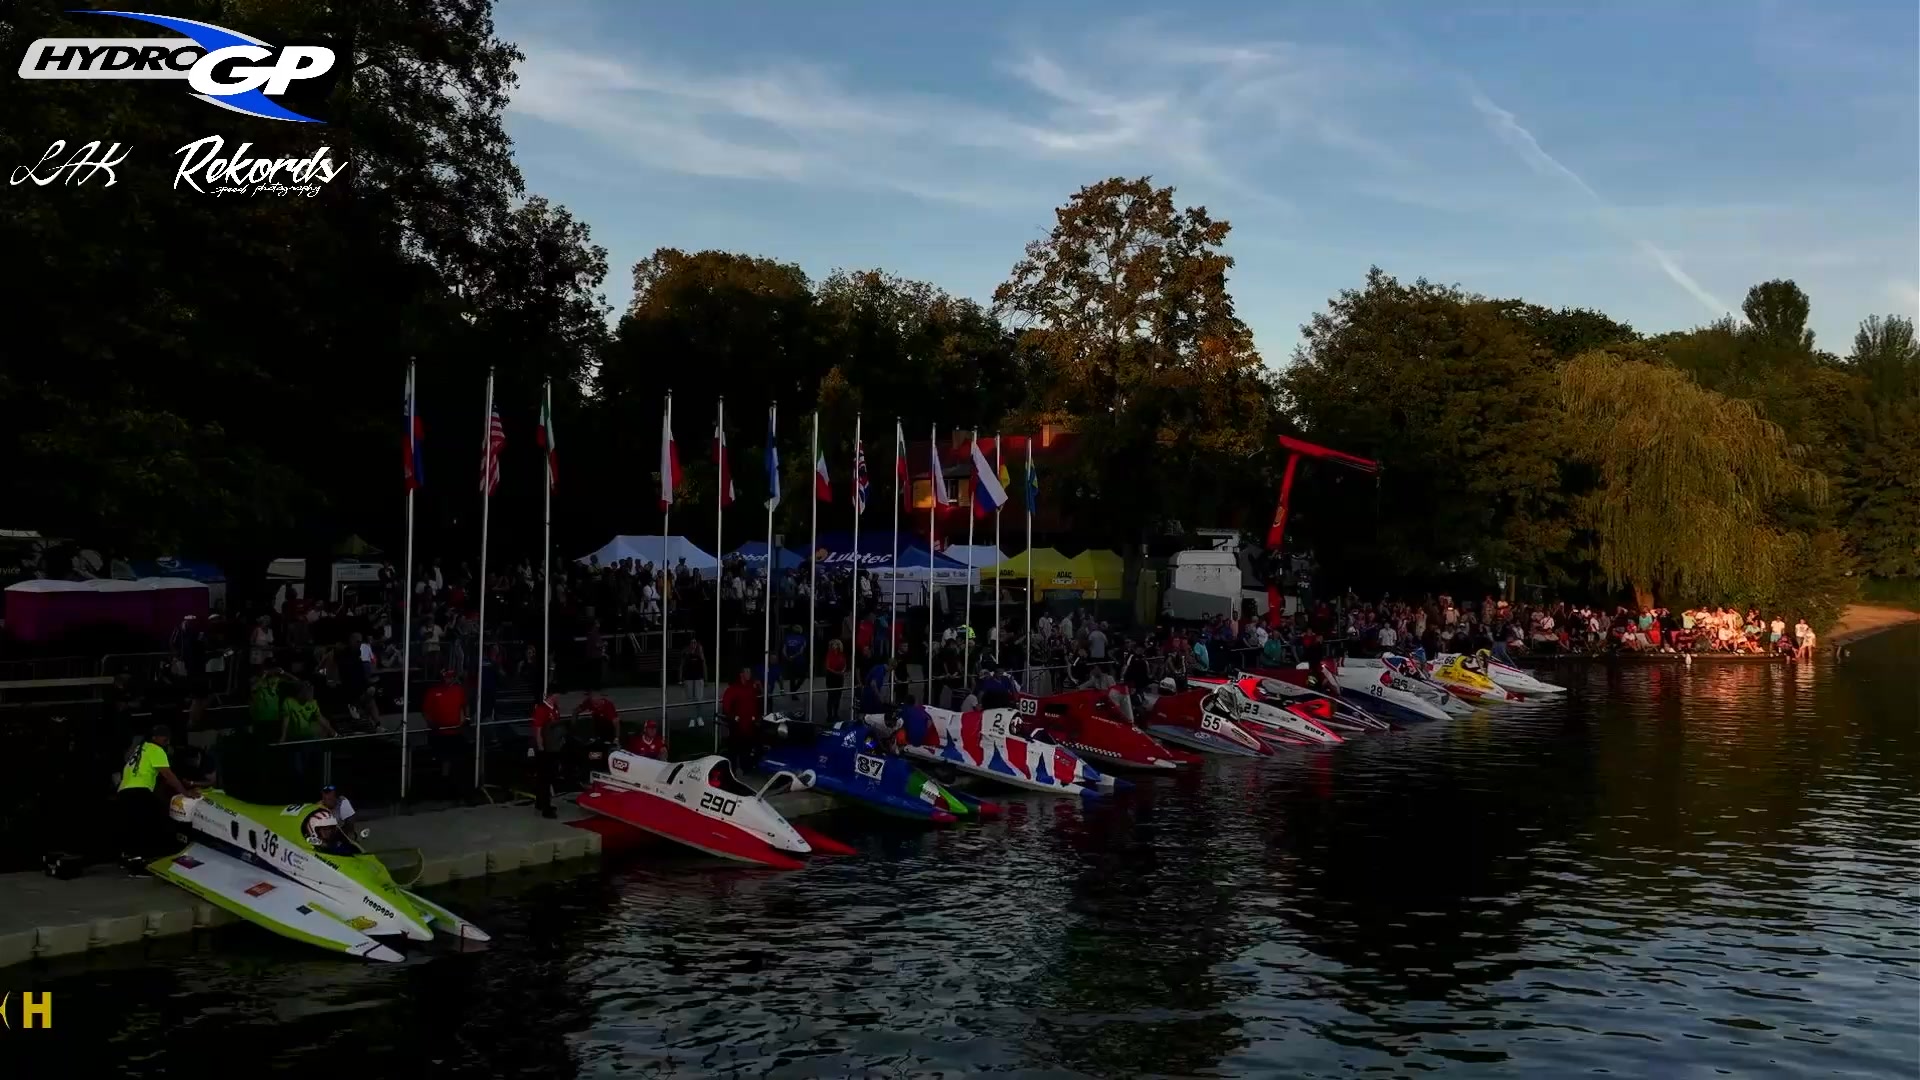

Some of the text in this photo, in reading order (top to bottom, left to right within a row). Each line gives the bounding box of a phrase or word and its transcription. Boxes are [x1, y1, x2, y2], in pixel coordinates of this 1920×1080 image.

[1371, 684, 1383, 697] 29
[1021, 701, 1036, 714] 99
[1244, 702, 1259, 715] 23
[993, 713, 1002, 728] 2
[1203, 715, 1221, 731] 55
[857, 756, 883, 777] 87
[701, 791, 736, 816] 290
[261, 829, 278, 857] 36
